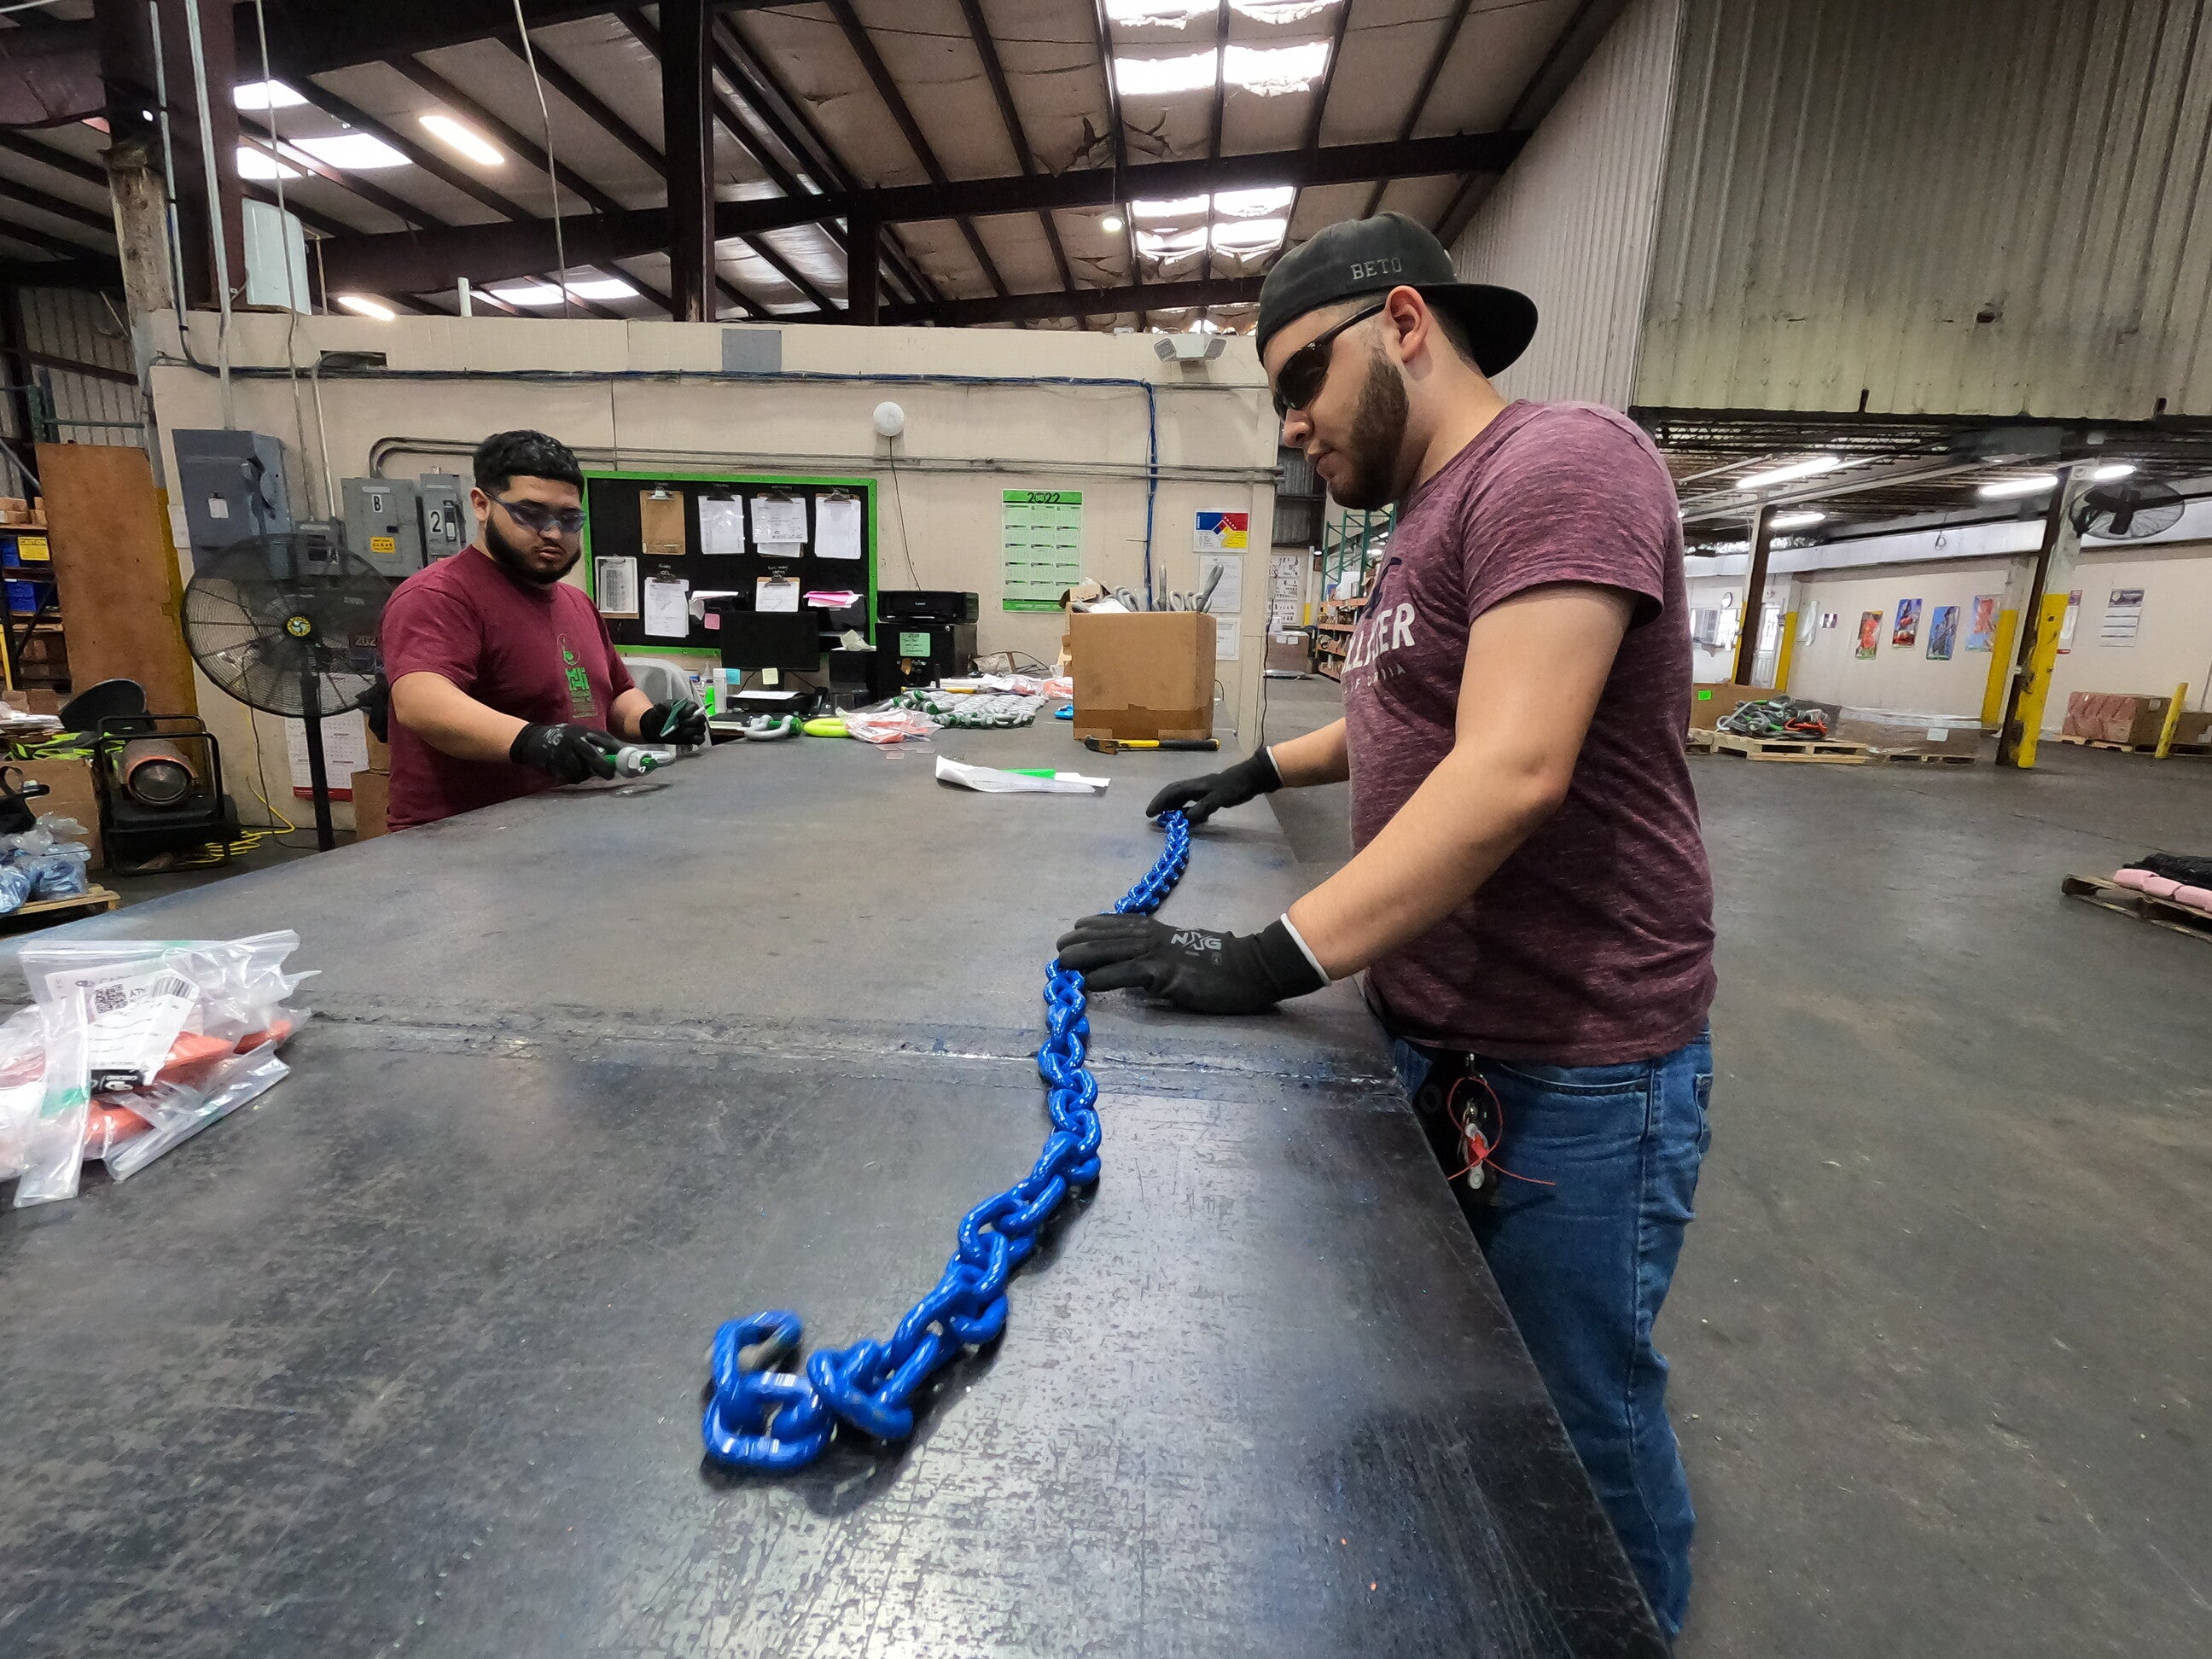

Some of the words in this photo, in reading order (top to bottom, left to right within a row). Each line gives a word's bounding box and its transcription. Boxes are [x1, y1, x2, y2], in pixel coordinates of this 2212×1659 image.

[1350, 258, 1402, 280] BETO
[374, 496, 381, 511] B
[1027, 492, 1061, 504] 2022
[430, 511, 441, 533] 2
